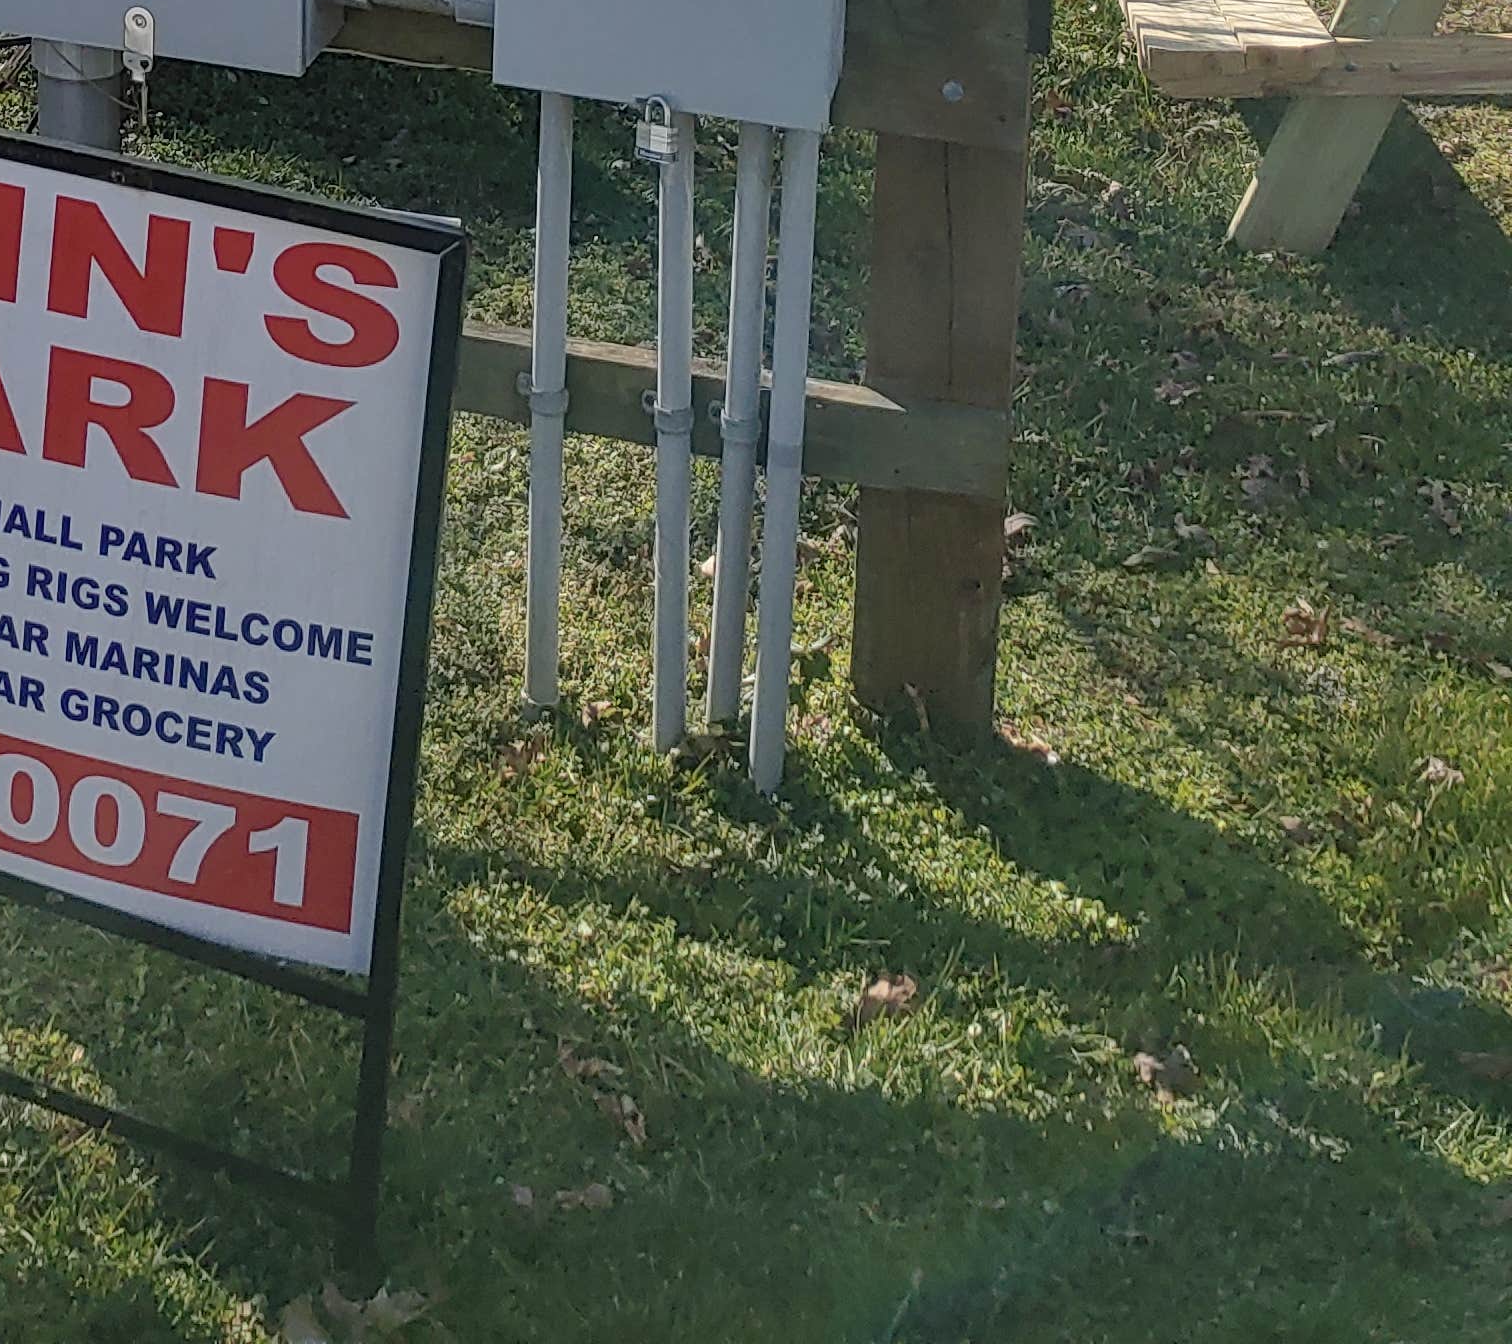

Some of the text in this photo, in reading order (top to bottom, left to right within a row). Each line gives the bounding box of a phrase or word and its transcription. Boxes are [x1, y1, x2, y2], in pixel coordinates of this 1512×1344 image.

[99, 523, 218, 580] PARK
[25, 563, 129, 617] RIGS
[143, 590, 374, 667] WELCOME
[65, 630, 271, 706] MARINAS
[60, 688, 278, 764] GROCERY
